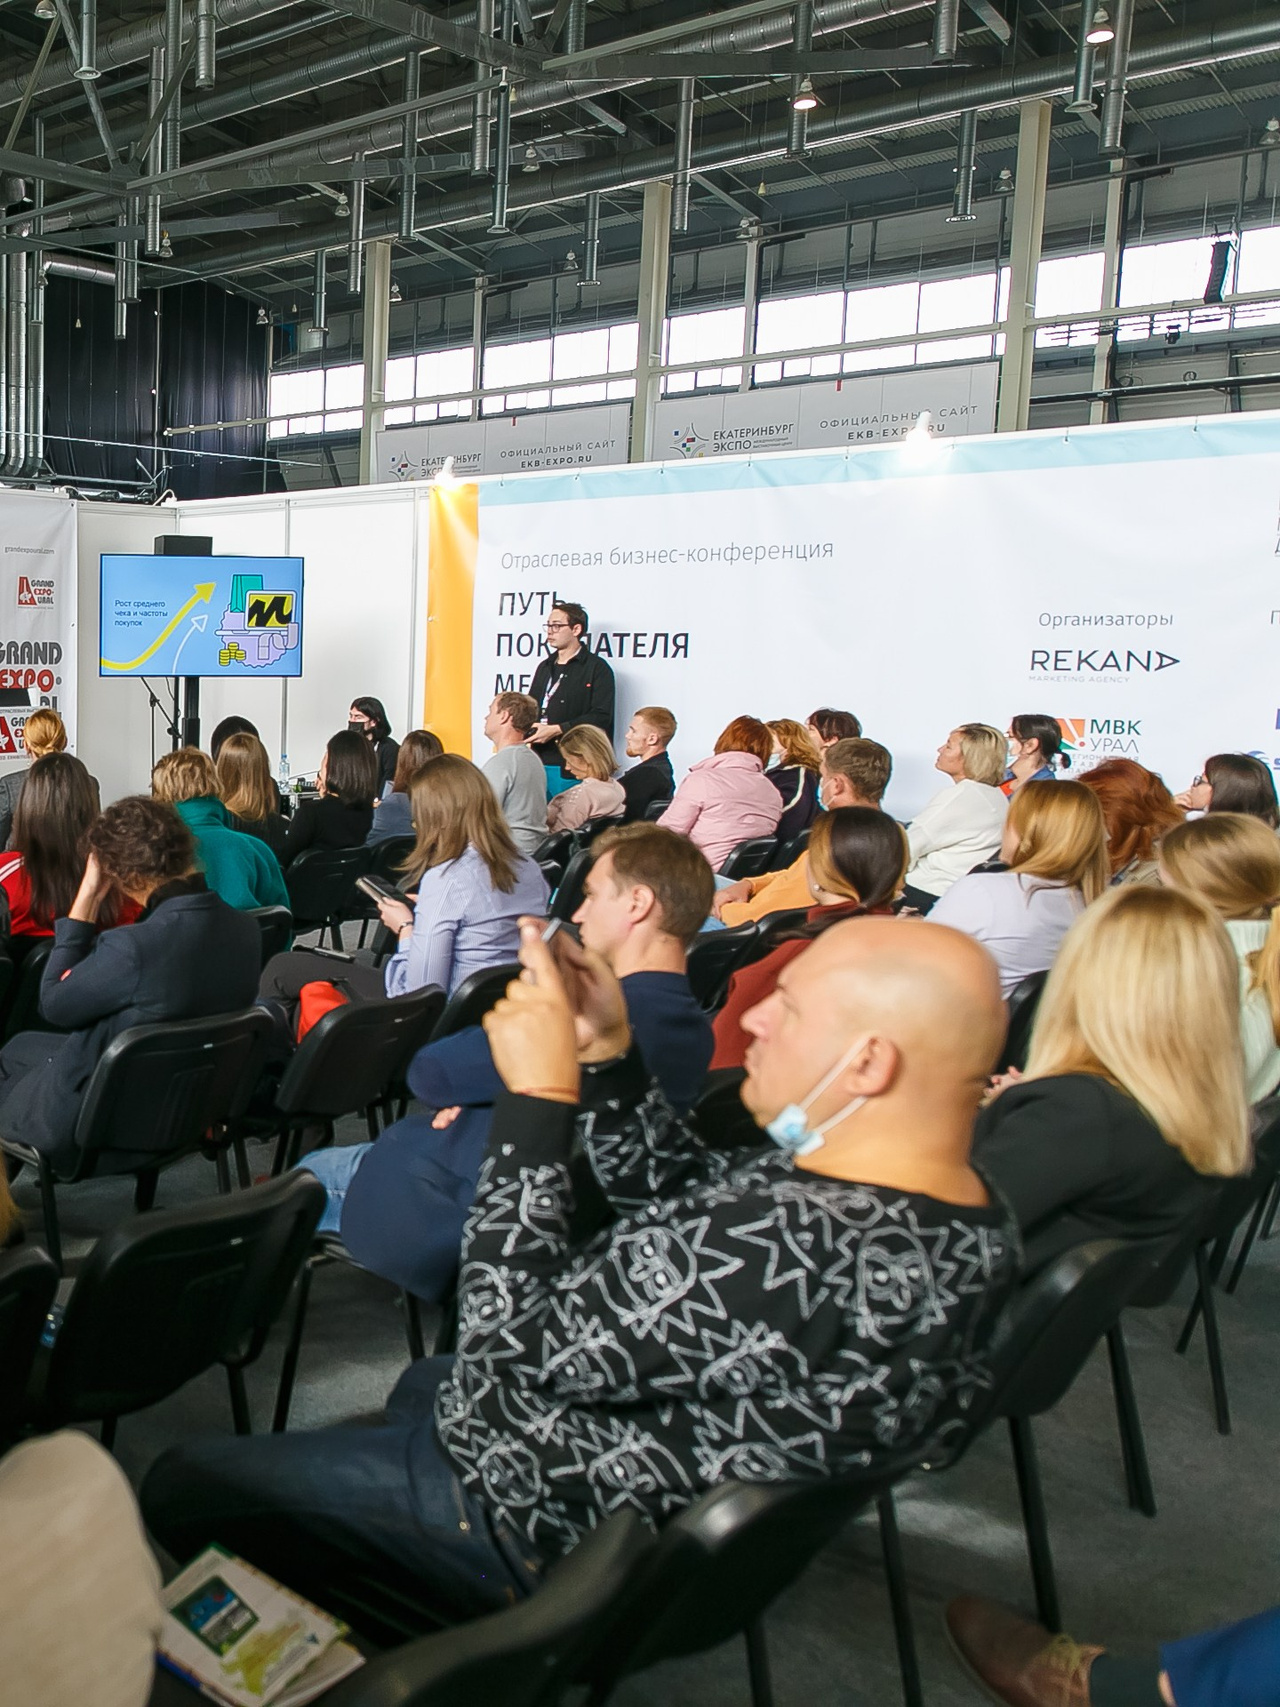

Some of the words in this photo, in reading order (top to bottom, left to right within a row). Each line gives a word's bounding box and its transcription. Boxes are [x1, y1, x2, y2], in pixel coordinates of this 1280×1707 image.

[939, 405, 978, 417] САЙТ
[713, 423, 794, 440] ЕКАТЕРИНБУРГ
[500, 442, 582, 458] ОФИЦИАЛЬНЫЙ
[587, 440, 616, 450] САЙТ
[713, 440, 752, 452] ЭКСПО
[421, 453, 481, 467] ЕКАТЕНБУРГ
[521, 455, 592, 468] EKB-EXPO.RU
[501, 552, 603, 572] Отраслевая
[609, 542, 834, 566] бизнес-конференция
[1039, 612, 1173, 629] Организаторы
[1029, 675, 1085, 683] MARKETING
[1090, 719, 1142, 736] МВК
[1090, 738, 1139, 753] УРАЛ
